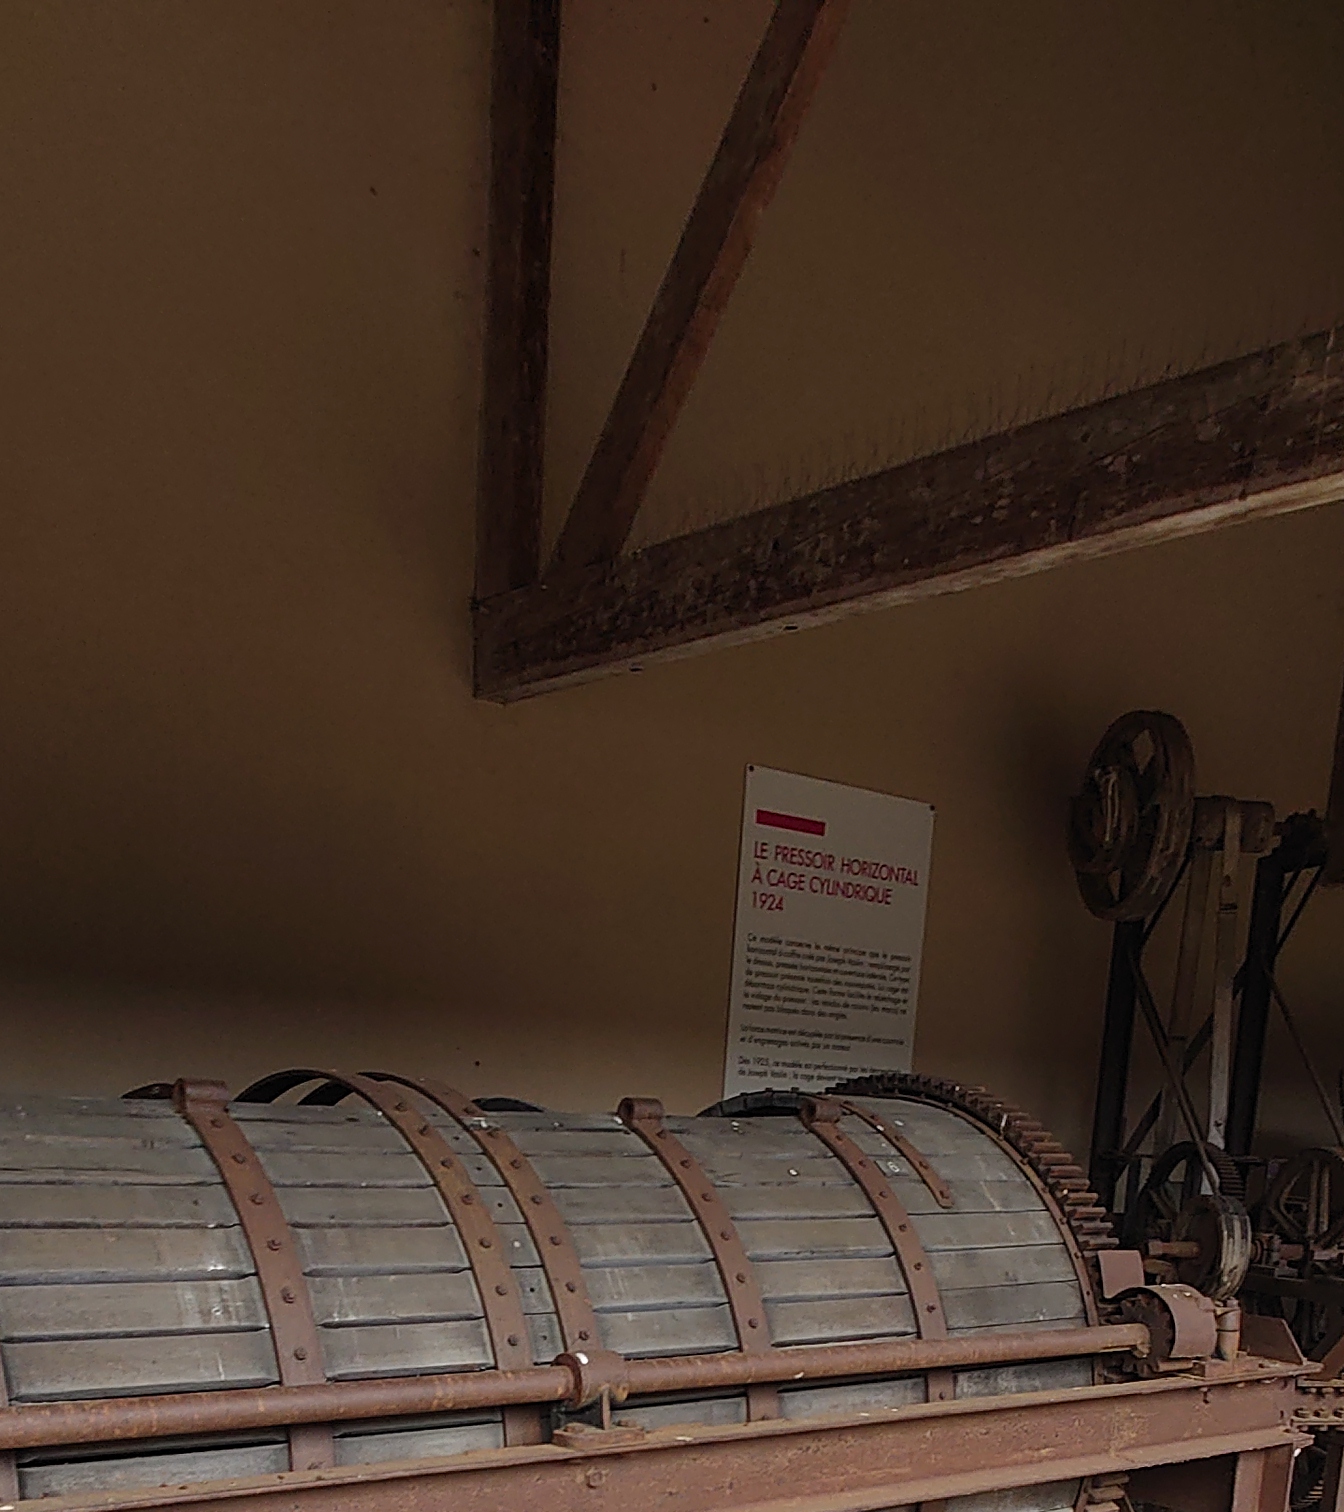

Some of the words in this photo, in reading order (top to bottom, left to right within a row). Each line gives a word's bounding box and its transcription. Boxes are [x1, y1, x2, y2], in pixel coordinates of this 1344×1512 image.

[751, 862, 763, 884] À
[767, 869, 805, 890] CAGE
[809, 876, 893, 905] CYLINDRIQUE
[754, 841, 768, 859] LE
[775, 845, 835, 871] PRESSOIR
[841, 857, 918, 886] HORIZONTAL
[752, 891, 784, 911] 1924
